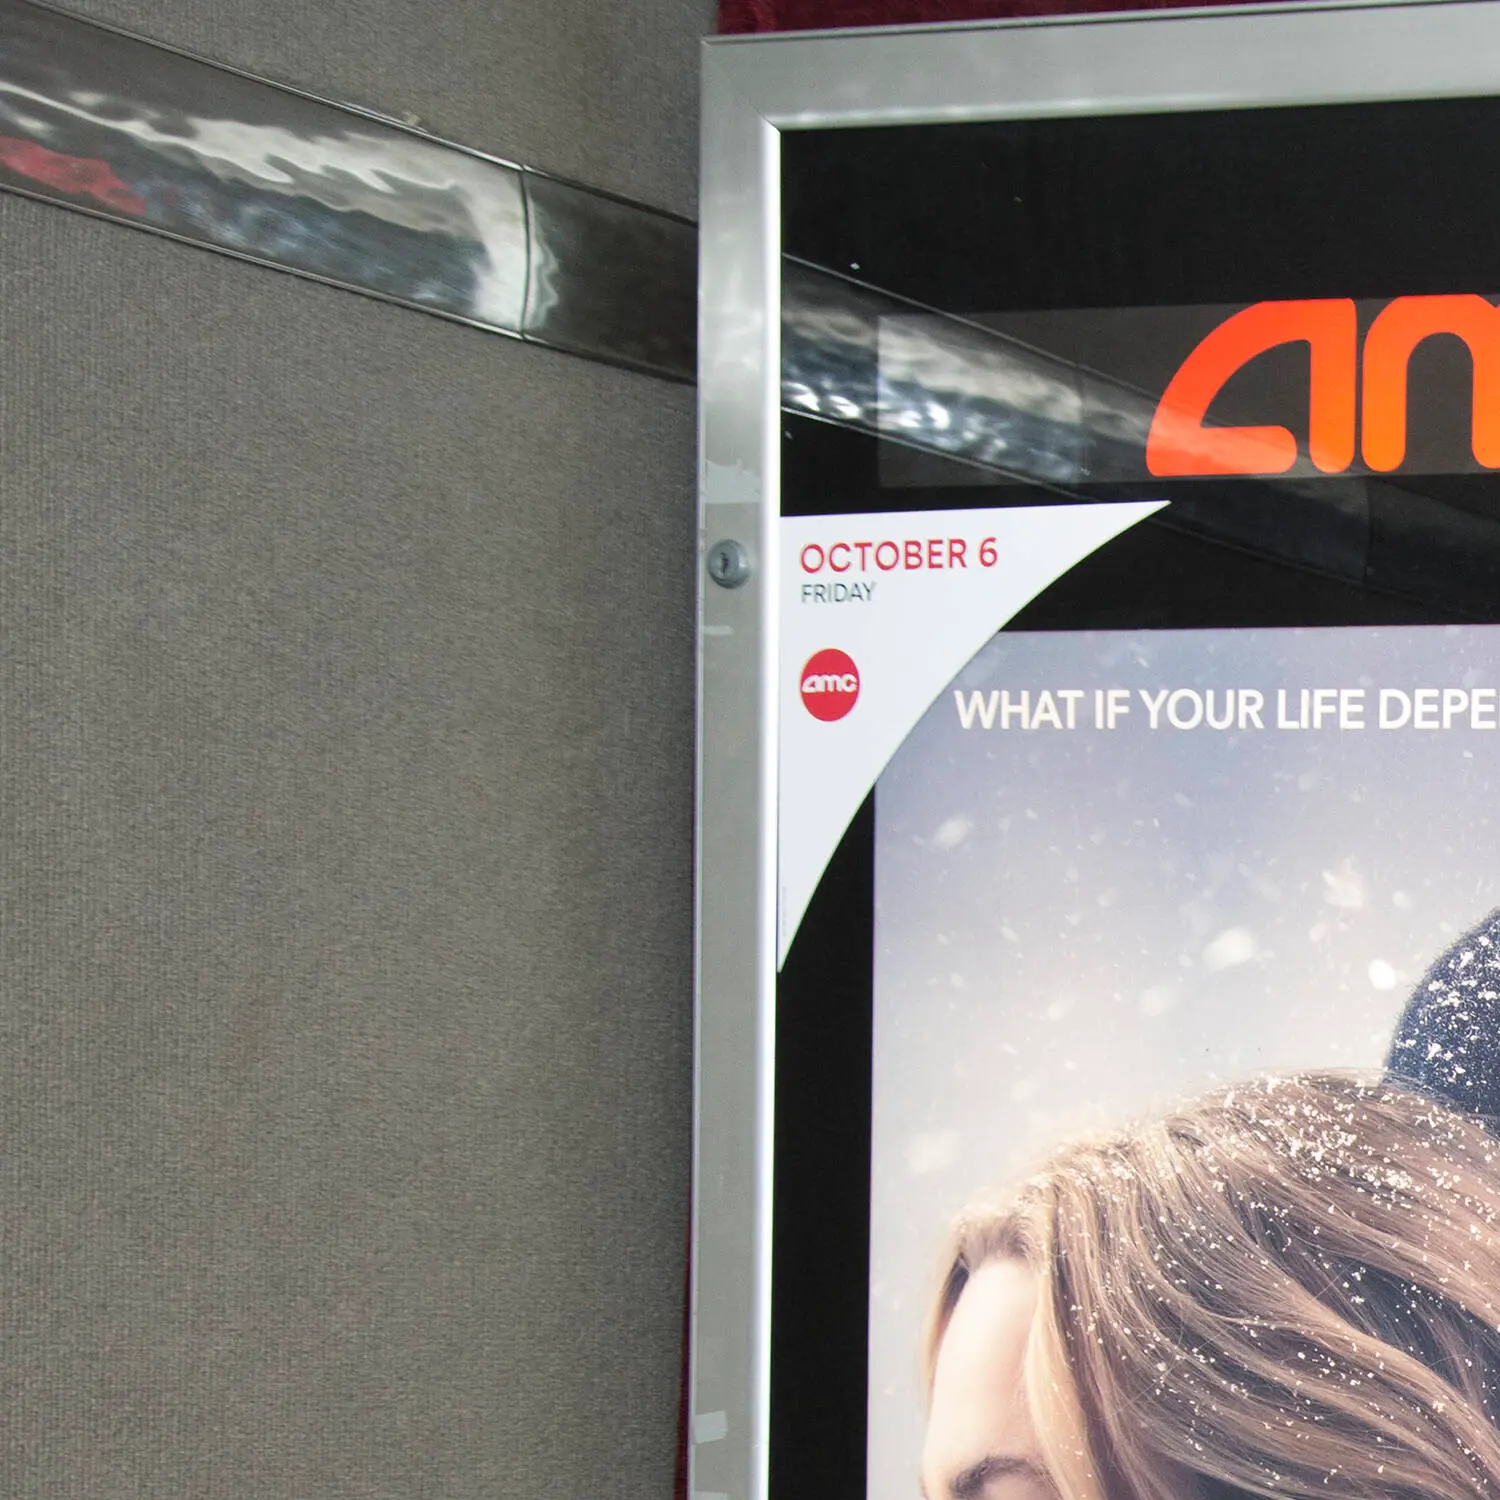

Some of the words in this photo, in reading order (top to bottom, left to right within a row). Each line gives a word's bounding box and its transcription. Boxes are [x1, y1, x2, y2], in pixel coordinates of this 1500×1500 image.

[800, 538, 968, 574] OCTOBER
[979, 537, 998, 568] 6
[801, 582, 876, 603] FRIDAY
[954, 689, 1085, 730] WHAT
[1096, 689, 1131, 730] IF
[1139, 688, 1264, 730] YOUR
[1277, 688, 1364, 730] LIFE
